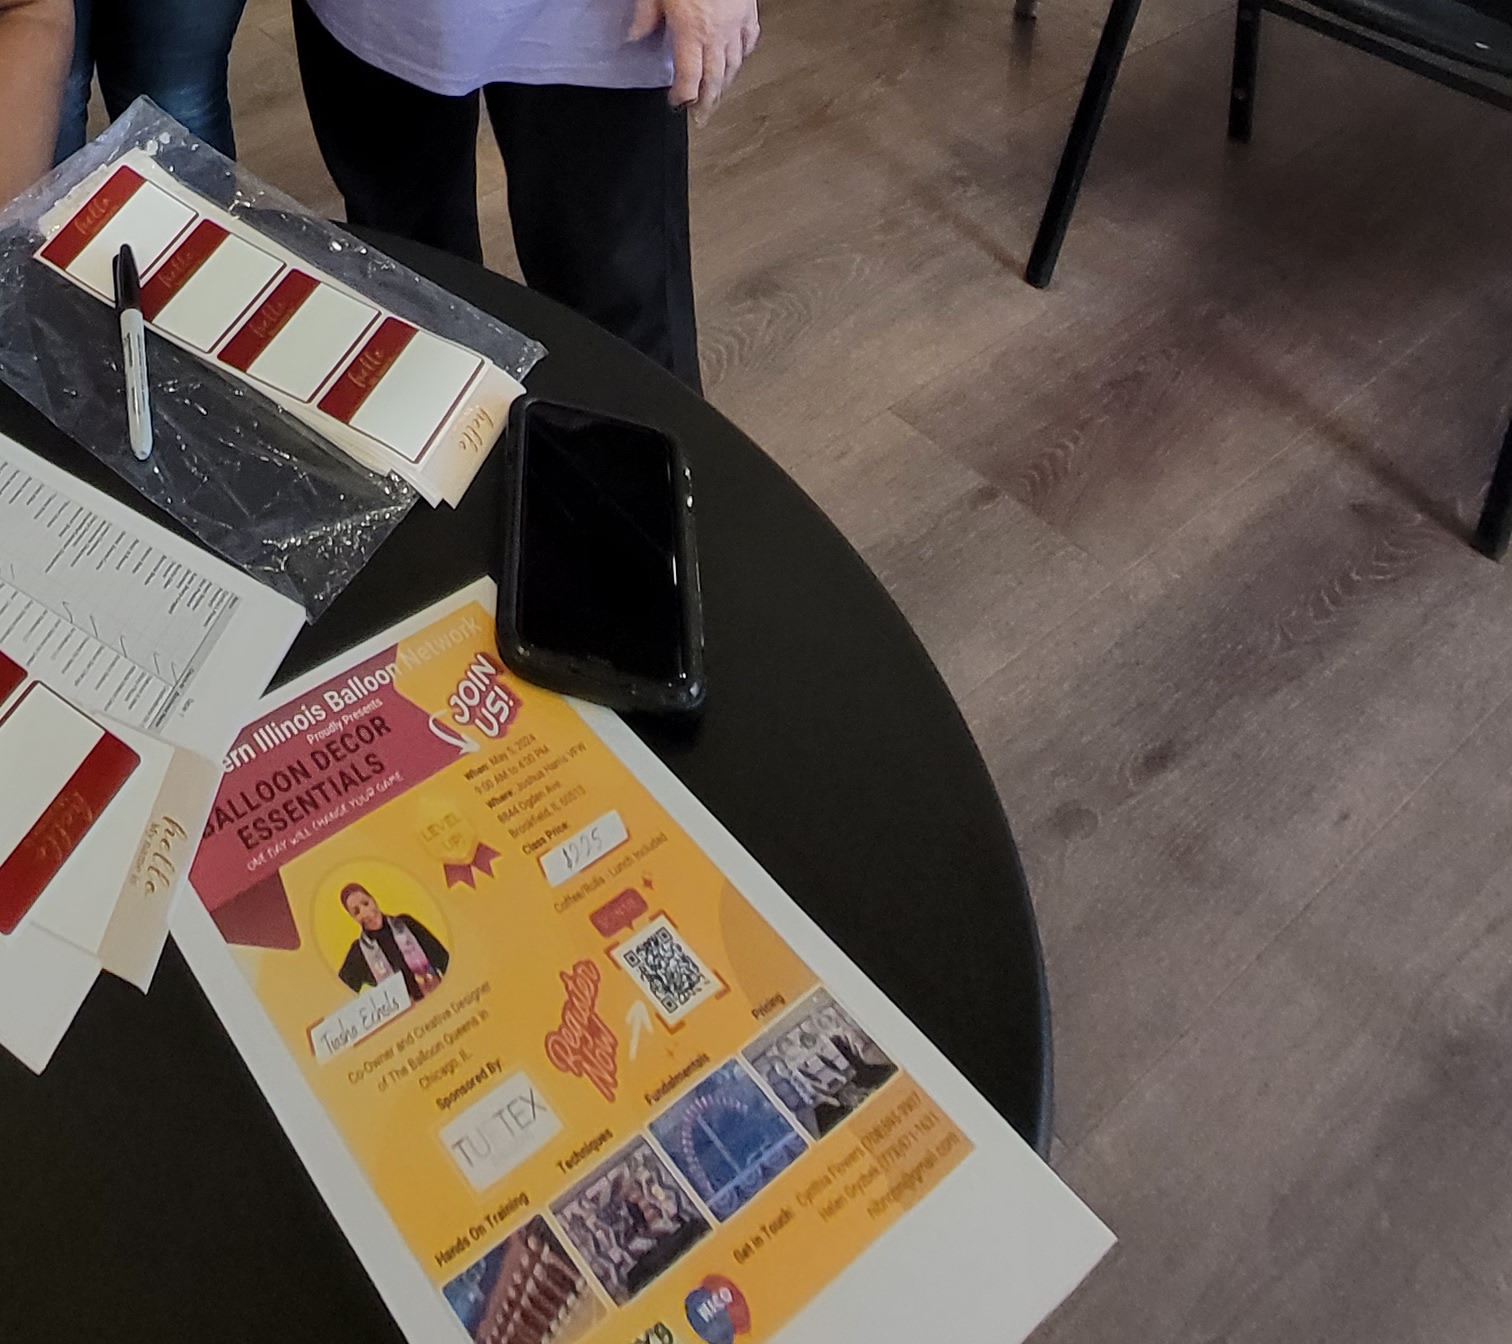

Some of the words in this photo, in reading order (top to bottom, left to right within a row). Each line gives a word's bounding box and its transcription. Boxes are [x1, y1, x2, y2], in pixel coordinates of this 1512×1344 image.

[253, 705, 325, 752] Illinois
[323, 663, 397, 712] Balloon
[402, 616, 480, 669] Network
[447, 653, 497, 724] JOIN
[307, 720, 343, 745] Proudly
[342, 699, 383, 725] Presents
[474, 688, 515, 738] US!
[310, 716, 390, 771] DECOR
[489, 752, 509, 767] May
[238, 753, 384, 849] ESSENTIALS
[494, 771, 509, 784] AM
[146, 816, 187, 895] hello
[522, 836, 546, 855] Class
[752, 993, 785, 1019] Pricing
[436, 1069, 487, 1111] Sponsored
[557, 1129, 613, 1173] Techniques
[435, 1236, 470, 1267] Hands
[469, 1222, 486, 1241] On
[484, 1192, 529, 1228] Training
